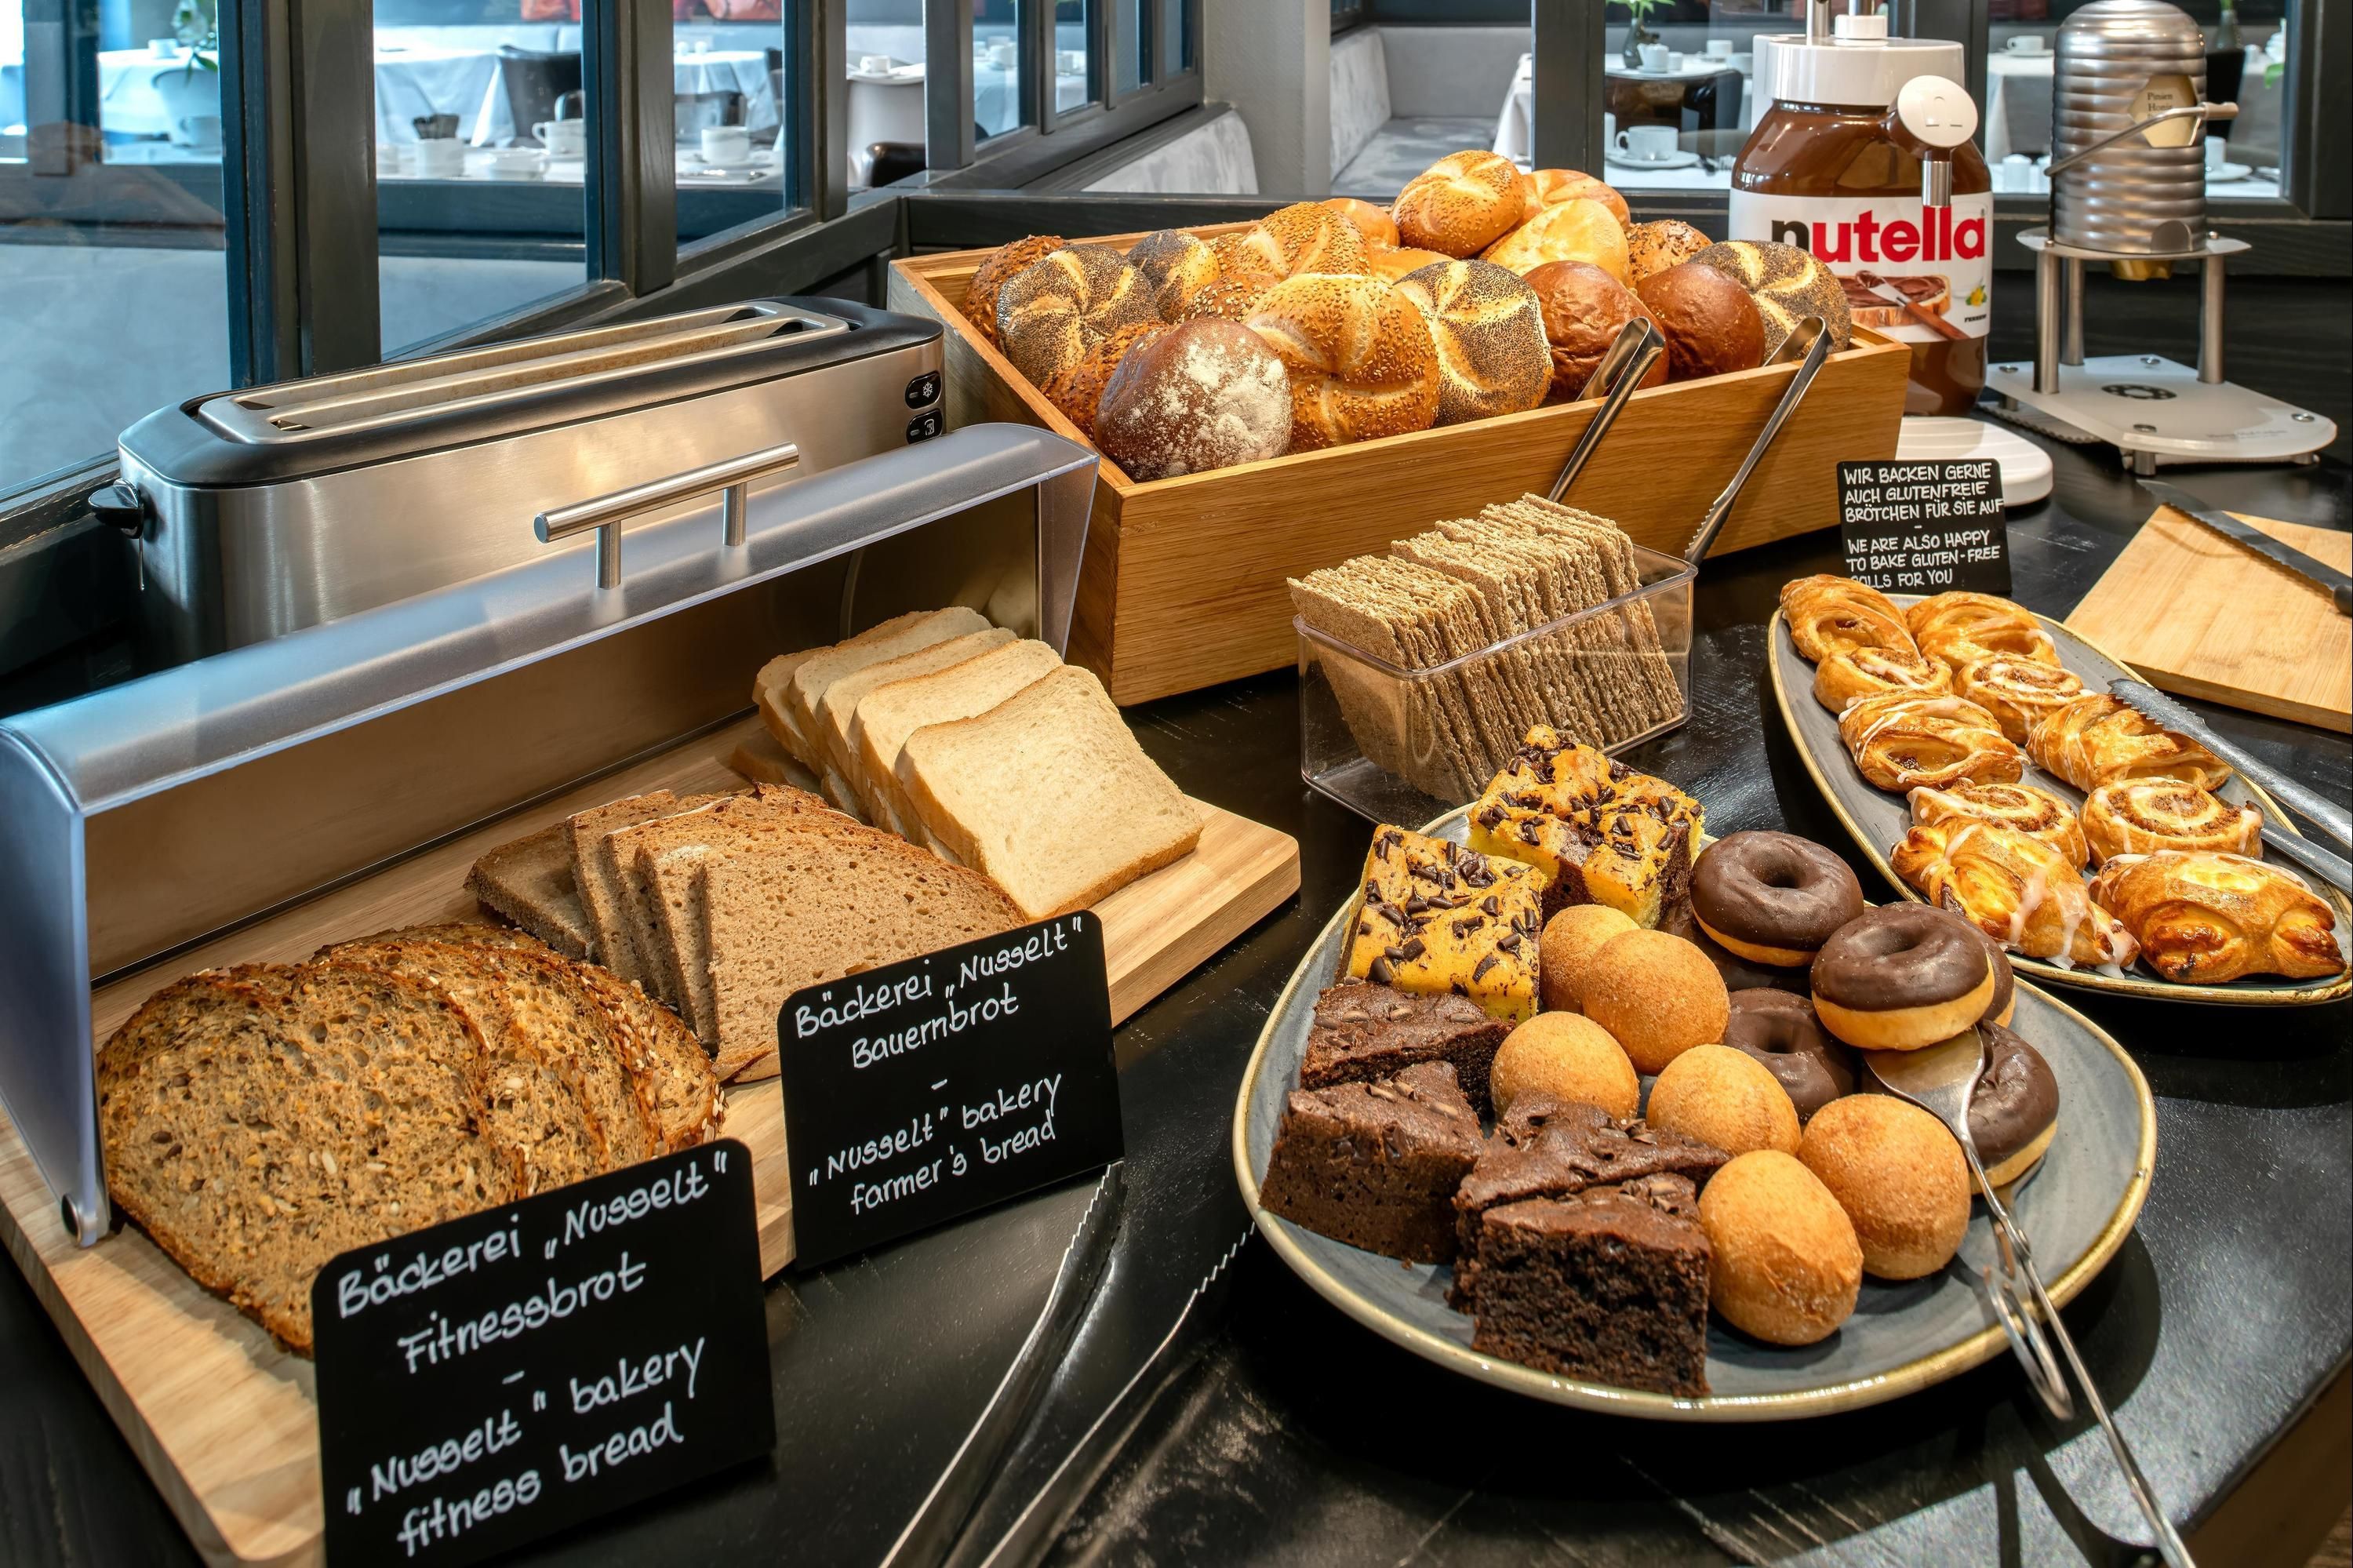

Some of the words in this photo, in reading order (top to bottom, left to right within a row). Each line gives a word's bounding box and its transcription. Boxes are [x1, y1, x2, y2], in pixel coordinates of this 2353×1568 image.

[1772, 206, 1985, 264] nutella
[1844, 467, 1874, 485] WIR
[1878, 465, 1939, 483] BACKEN
[1945, 463, 1992, 481] GERNE
[1845, 488, 1881, 504] AUCH
[1886, 482, 1989, 500] GLUTENFREIE
[1846, 504, 1920, 522] BRÖTCHEN
[1926, 500, 1951, 518] FÜR
[1980, 498, 2004, 515] AUF
[1846, 558, 1866, 572] TO
[1871, 554, 1907, 569] BAKE
[1847, 539, 1867, 554] WE
[1871, 537, 1898, 553] ARE
[1903, 534, 1940, 550] ALSO
[1944, 529, 1990, 548] HAPPY
[1898, 572, 1925, 587] FOR
[1926, 568, 1953, 584] YOU
[795, 959, 932, 1039] Bäckerei
[852, 983, 1019, 1069] Bauernbrot
[962, 1074, 1061, 1129] bakery
[980, 1108, 1056, 1164] bread
[337, 1214, 521, 1319] Bäckerei
[397, 1251, 646, 1374] Fitnessbrot
[570, 1337, 706, 1413] bakery
[396, 1470, 541, 1556] fitness
[560, 1401, 684, 1483] bread
